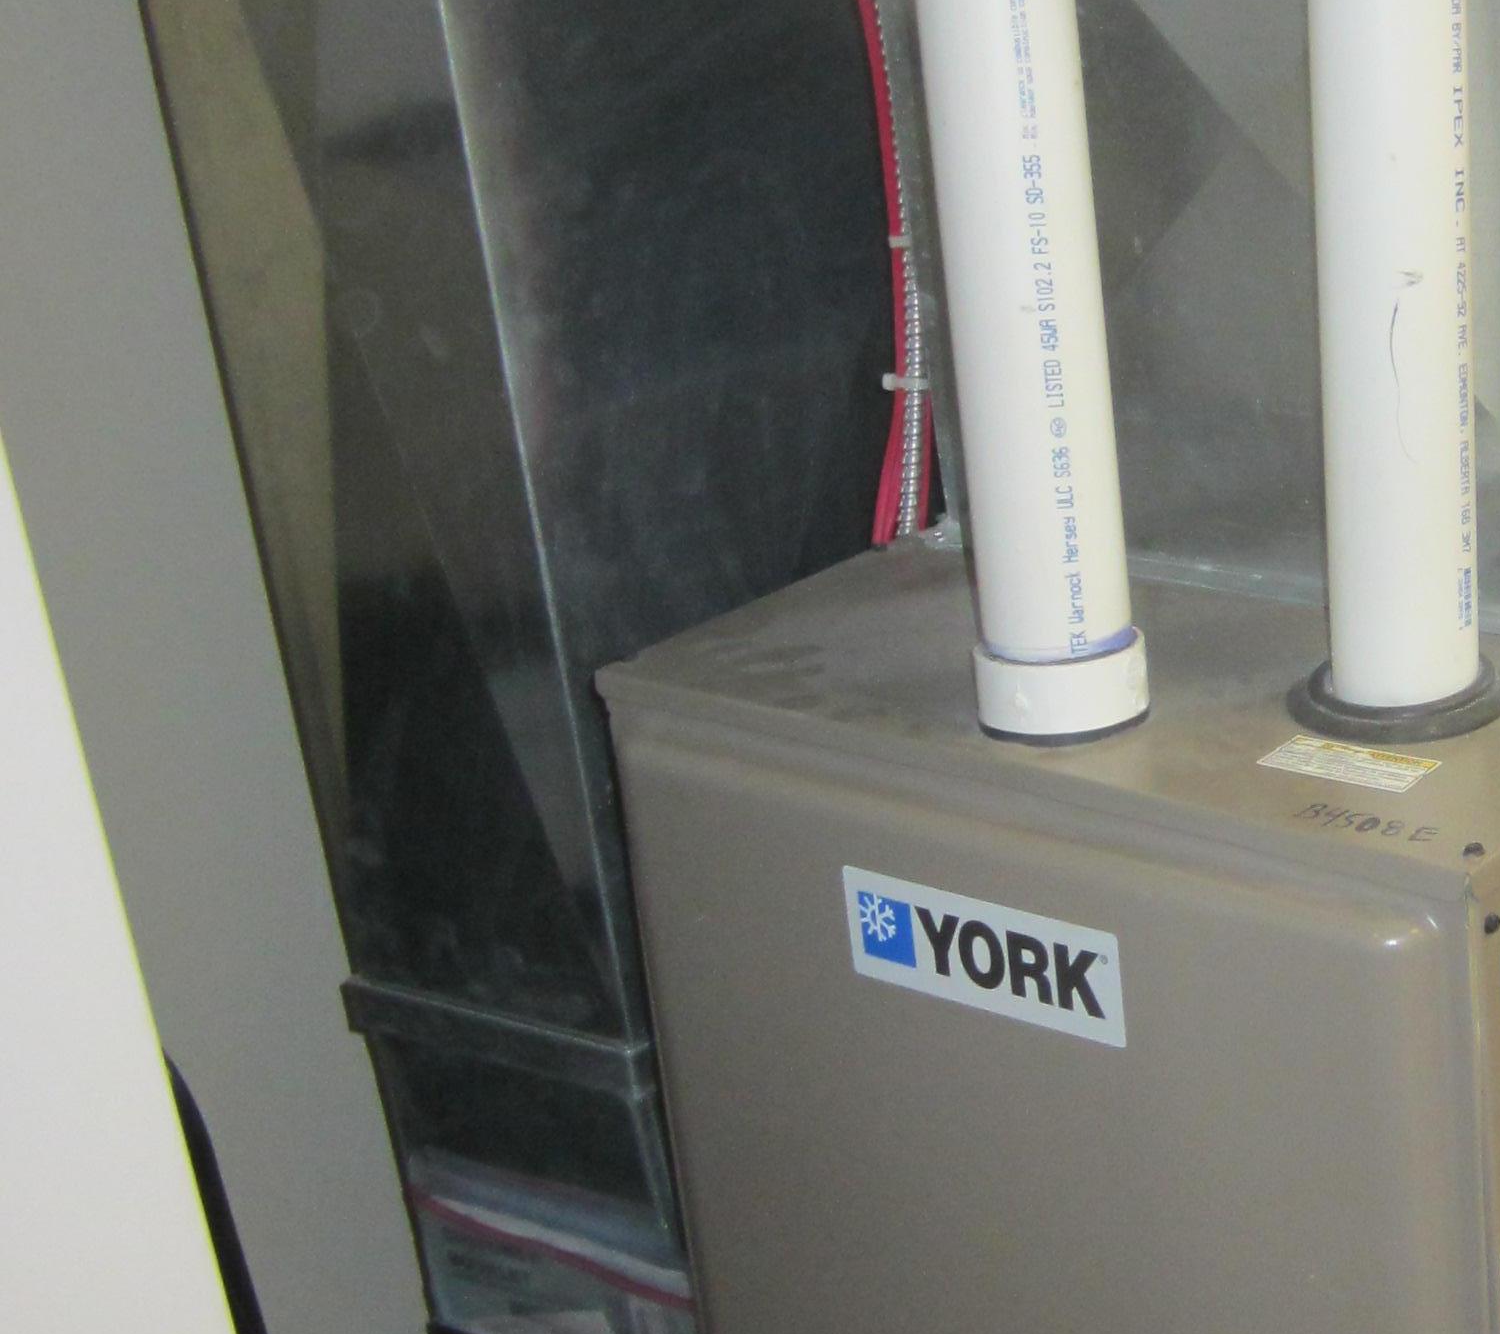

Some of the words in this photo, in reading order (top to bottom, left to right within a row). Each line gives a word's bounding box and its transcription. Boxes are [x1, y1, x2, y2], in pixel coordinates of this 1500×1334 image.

[1452, 86, 1464, 148] IPEX
[1022, 155, 1045, 205] SD-355
[1029, 211, 1049, 255] FS-10
[1033, 262, 1055, 312] S102.2
[1043, 359, 1065, 408] LISTED
[1052, 445, 1072, 479] S636
[1061, 516, 1080, 564] Hersey
[913, 904, 1107, 1019] YORK
